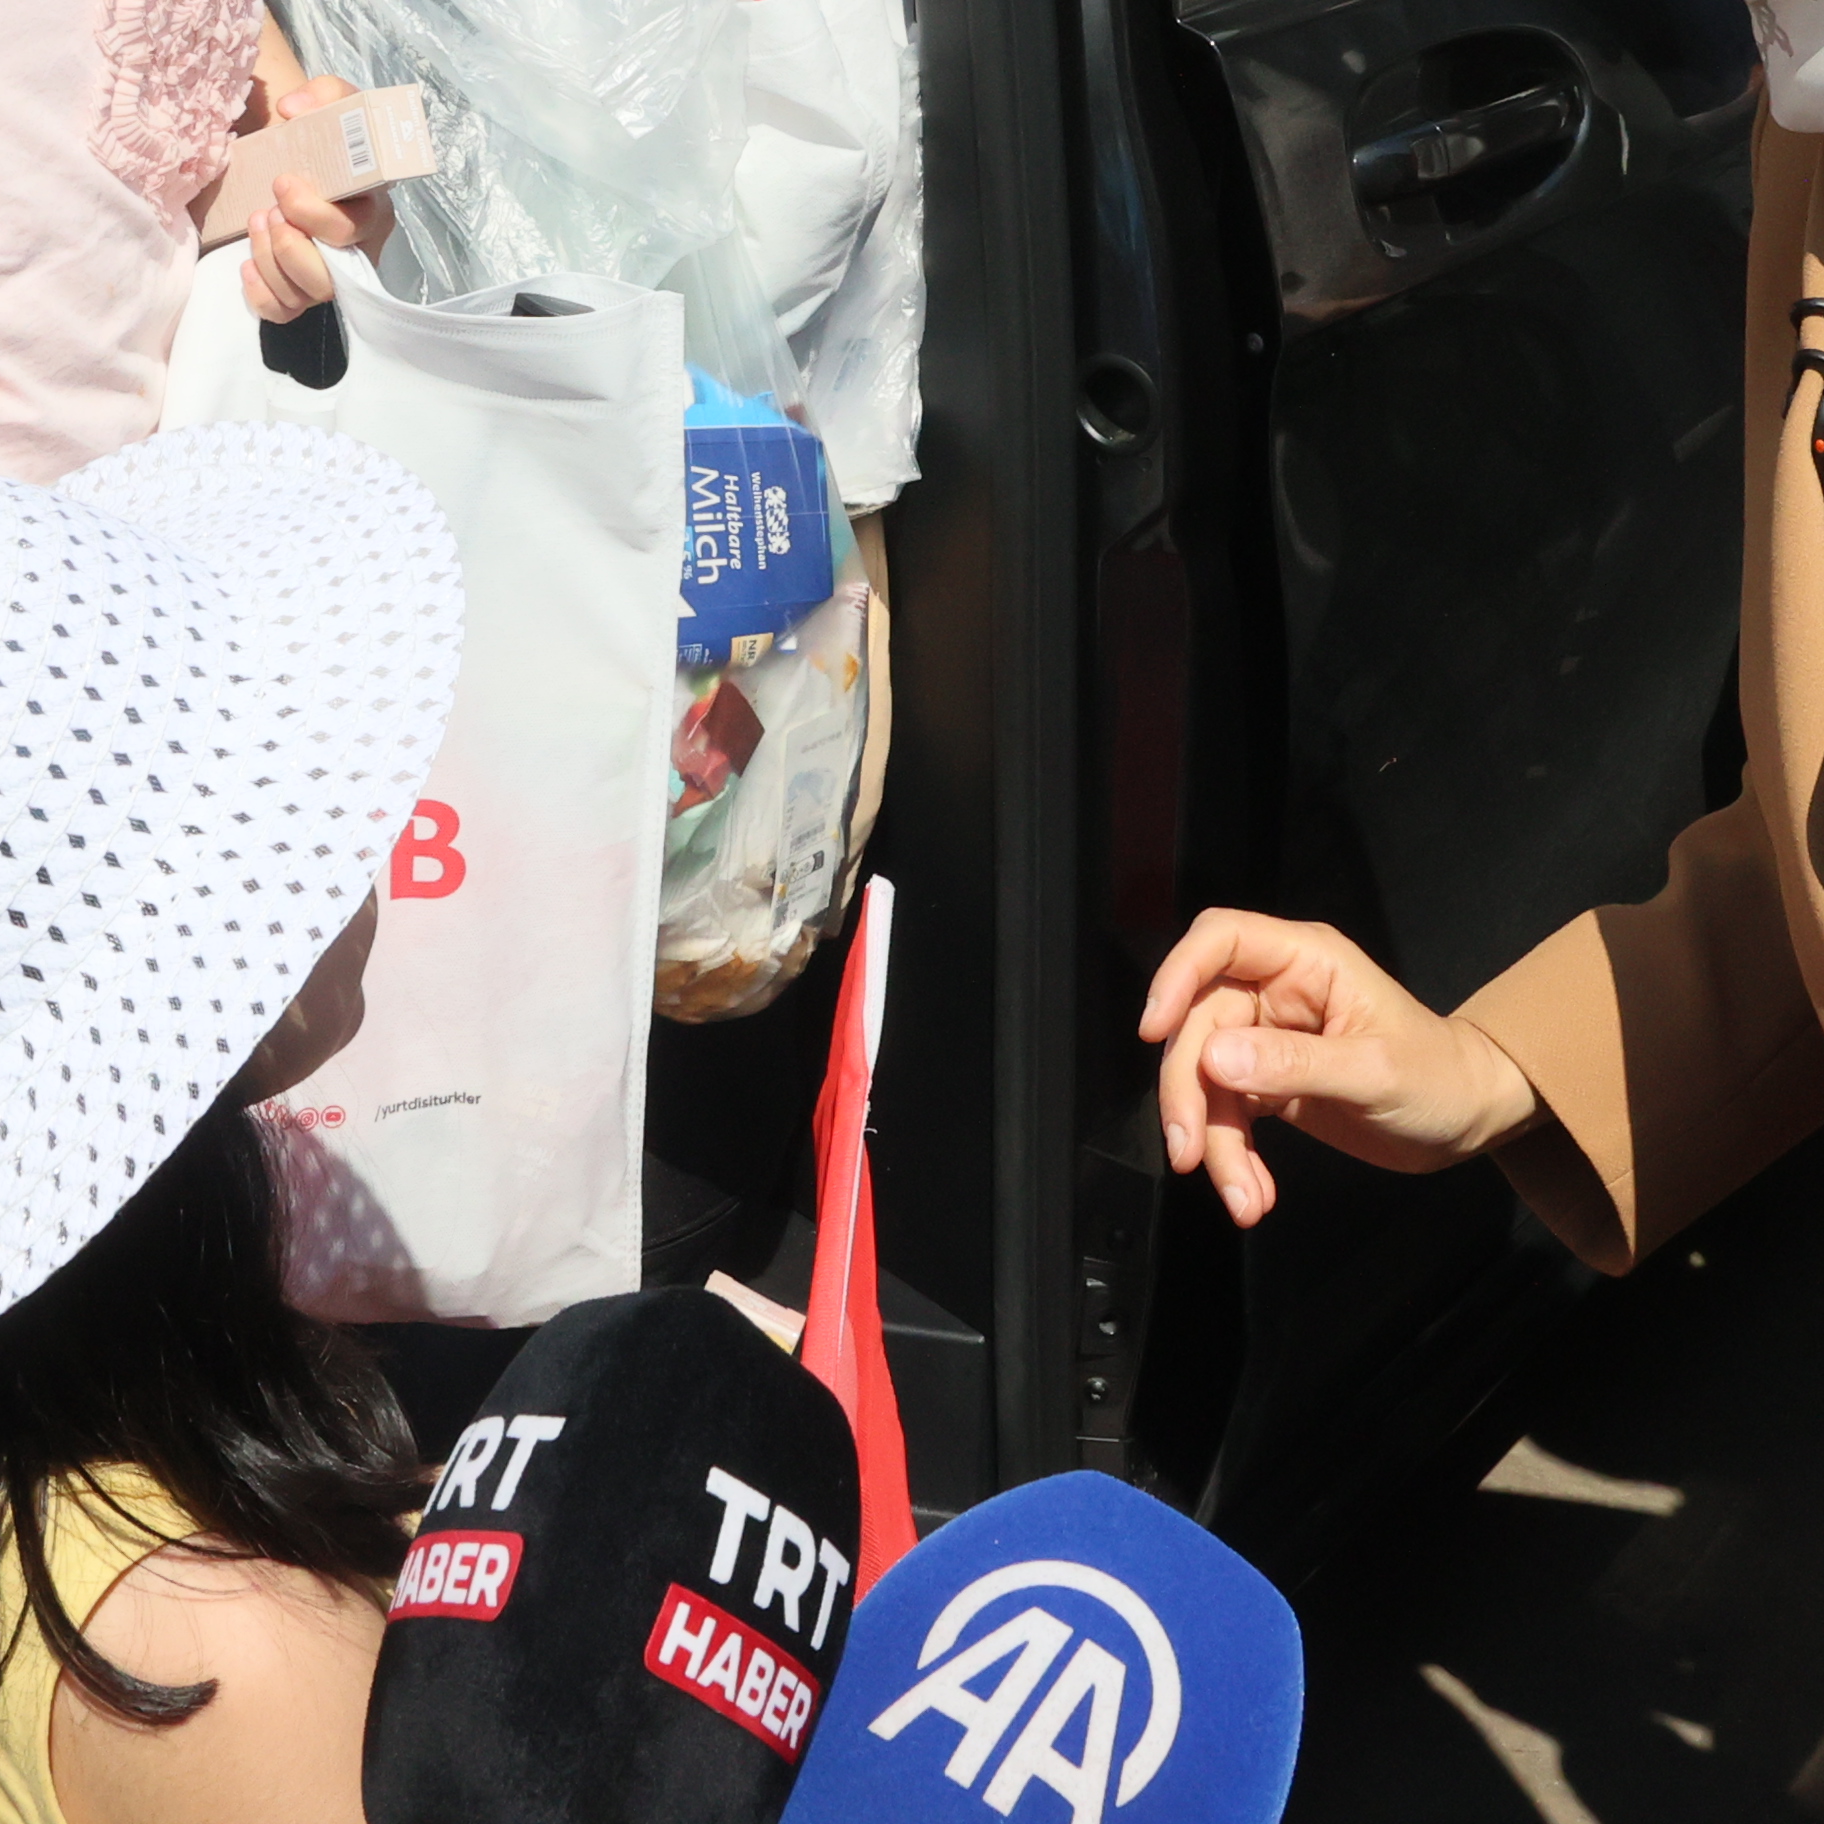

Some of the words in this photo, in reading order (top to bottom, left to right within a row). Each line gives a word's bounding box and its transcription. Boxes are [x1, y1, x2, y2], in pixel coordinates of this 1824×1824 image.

[690, 465, 728, 585] Milch
[723, 473, 744, 570] Haltbare
[750, 471, 767, 570] Weihenstephan
[374, 1091, 482, 1123] /yurtdisiturkler
[705, 1466, 850, 1651] TRT
[657, 1601, 813, 1750] HABER
[867, 1606, 1127, 1824] AA
